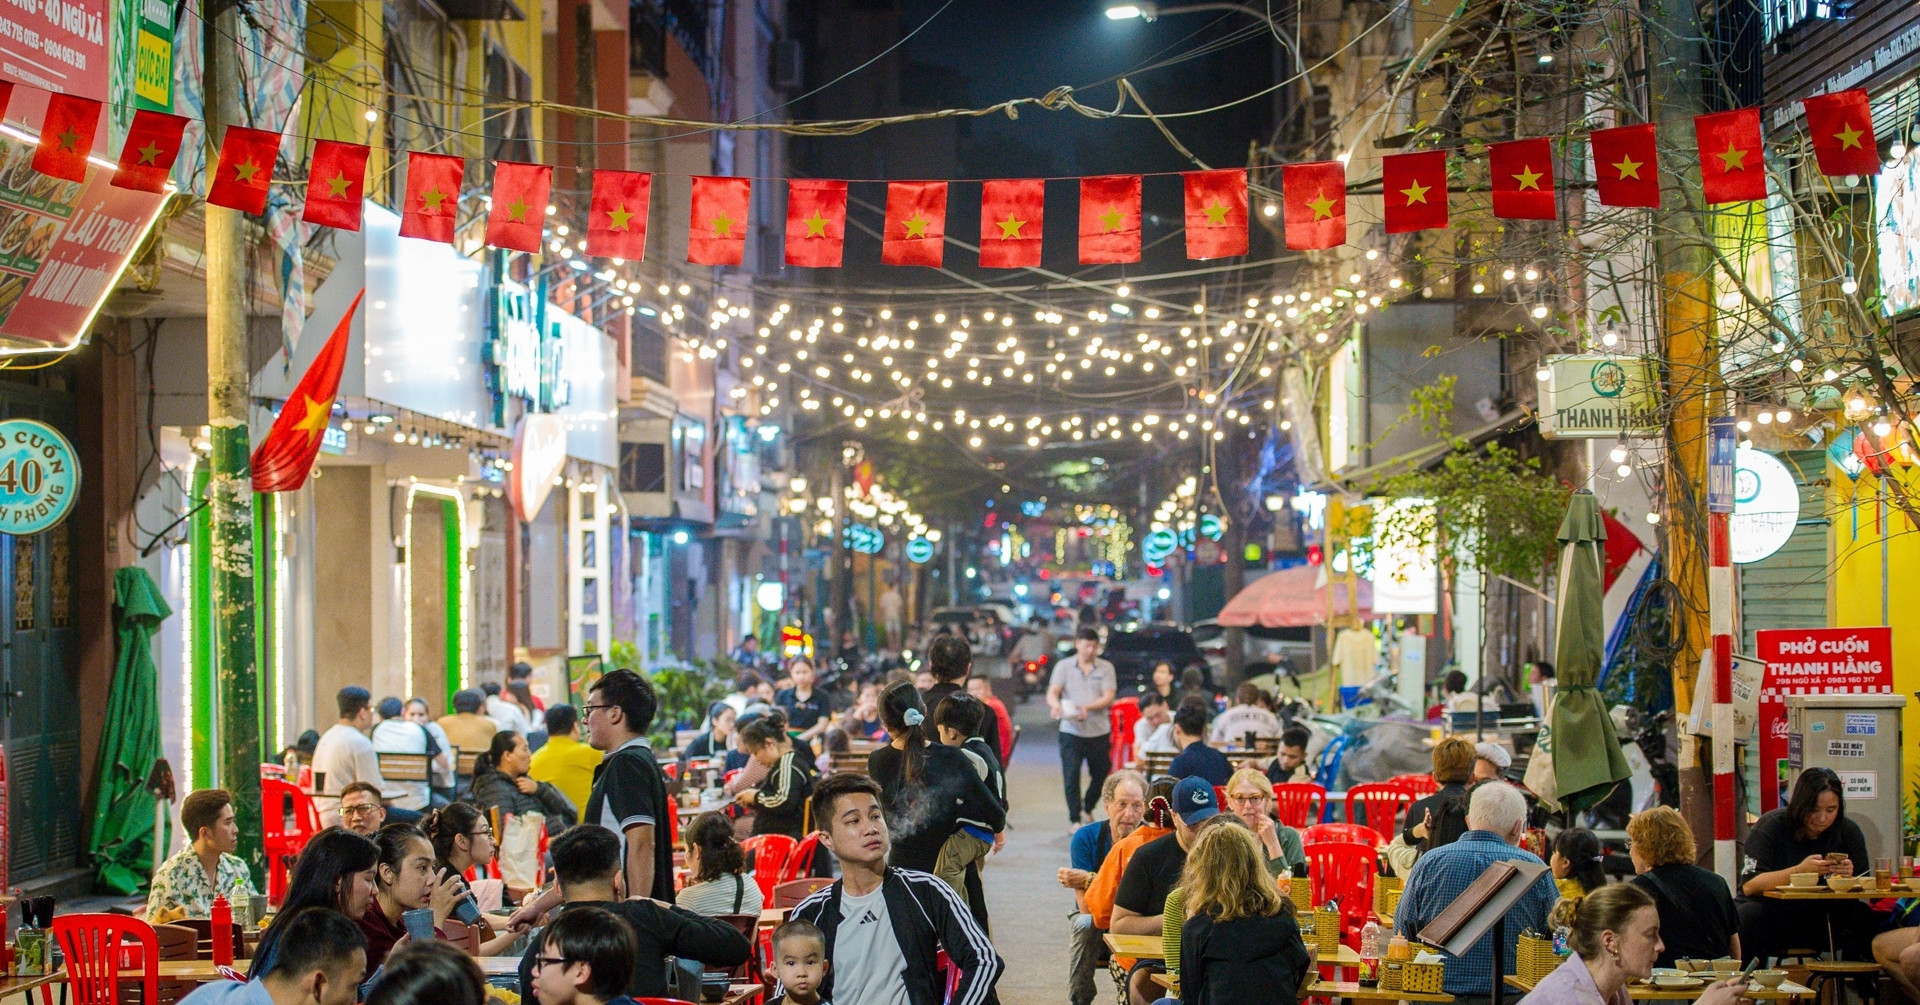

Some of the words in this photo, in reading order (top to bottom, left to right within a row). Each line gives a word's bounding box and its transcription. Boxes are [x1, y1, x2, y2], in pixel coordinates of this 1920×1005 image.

[1557, 408, 1613, 429] THANH
[15, 431, 65, 474] CUỐN
[0, 460, 42, 494] 40
[14, 485, 65, 524] PHONG
[1779, 636, 1817, 655] PHỞ
[1820, 635, 1869, 654] CUỐN
[1768, 662, 1829, 676] THANH
[1832, 655, 1882, 675] HẰNG
[1792, 676, 1809, 685] NGŨ
[1810, 676, 1821, 684] XÃ
